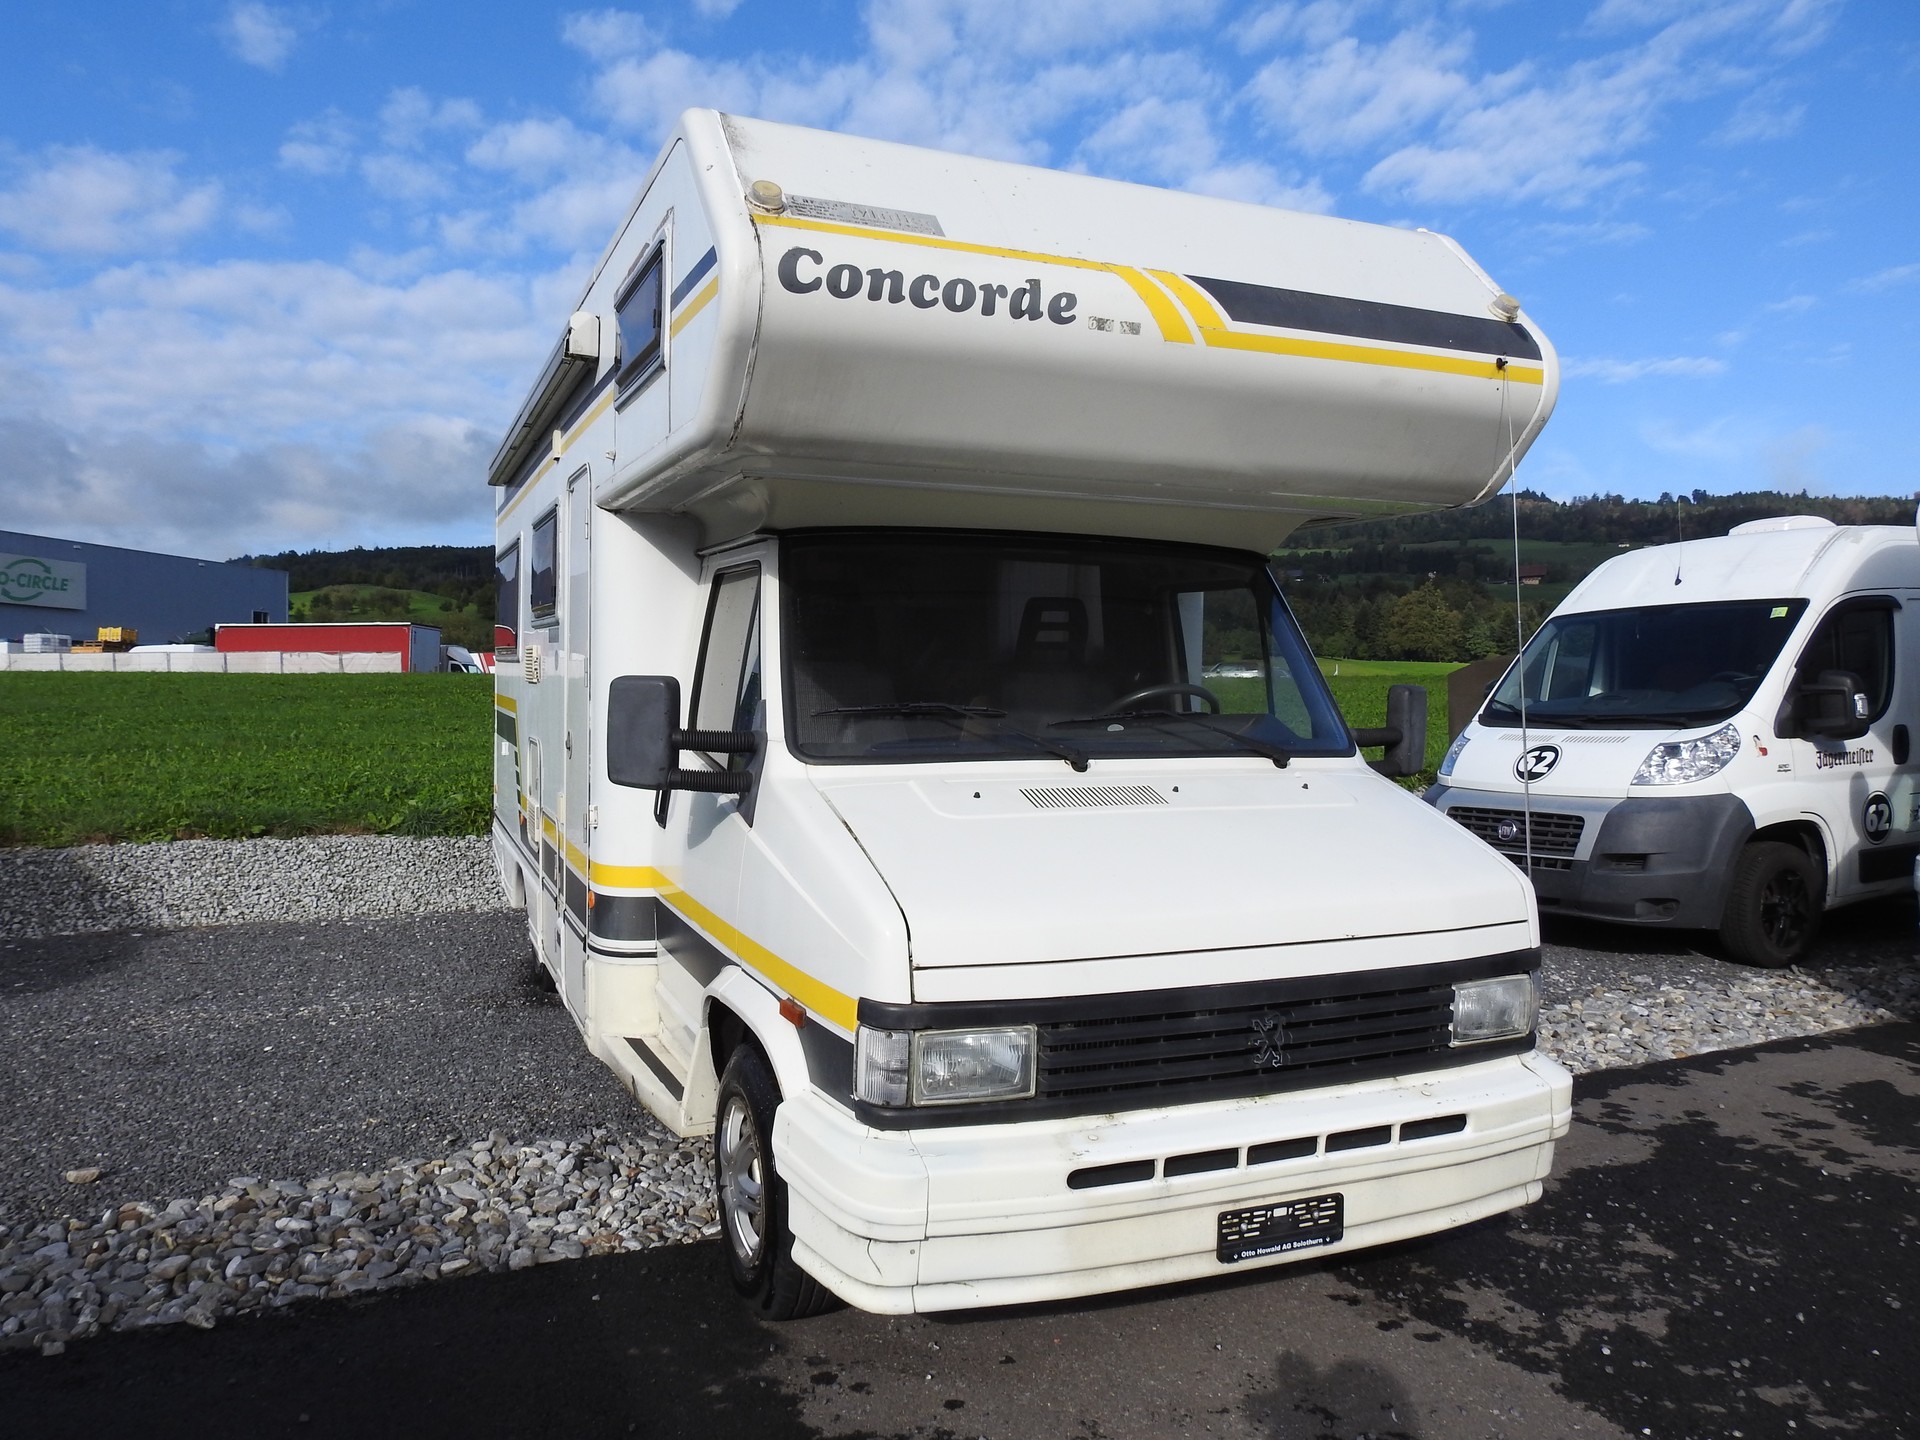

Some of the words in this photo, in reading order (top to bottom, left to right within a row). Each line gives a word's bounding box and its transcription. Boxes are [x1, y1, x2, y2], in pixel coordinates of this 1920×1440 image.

[778, 246, 1078, 325] Concorde
[1518, 750, 1556, 773] 62
[1865, 803, 1890, 833] 62
[1241, 1250, 1256, 1258] Otto
[1282, 1242, 1292, 1250] AG
[1292, 1237, 1323, 1248] Solothurn
